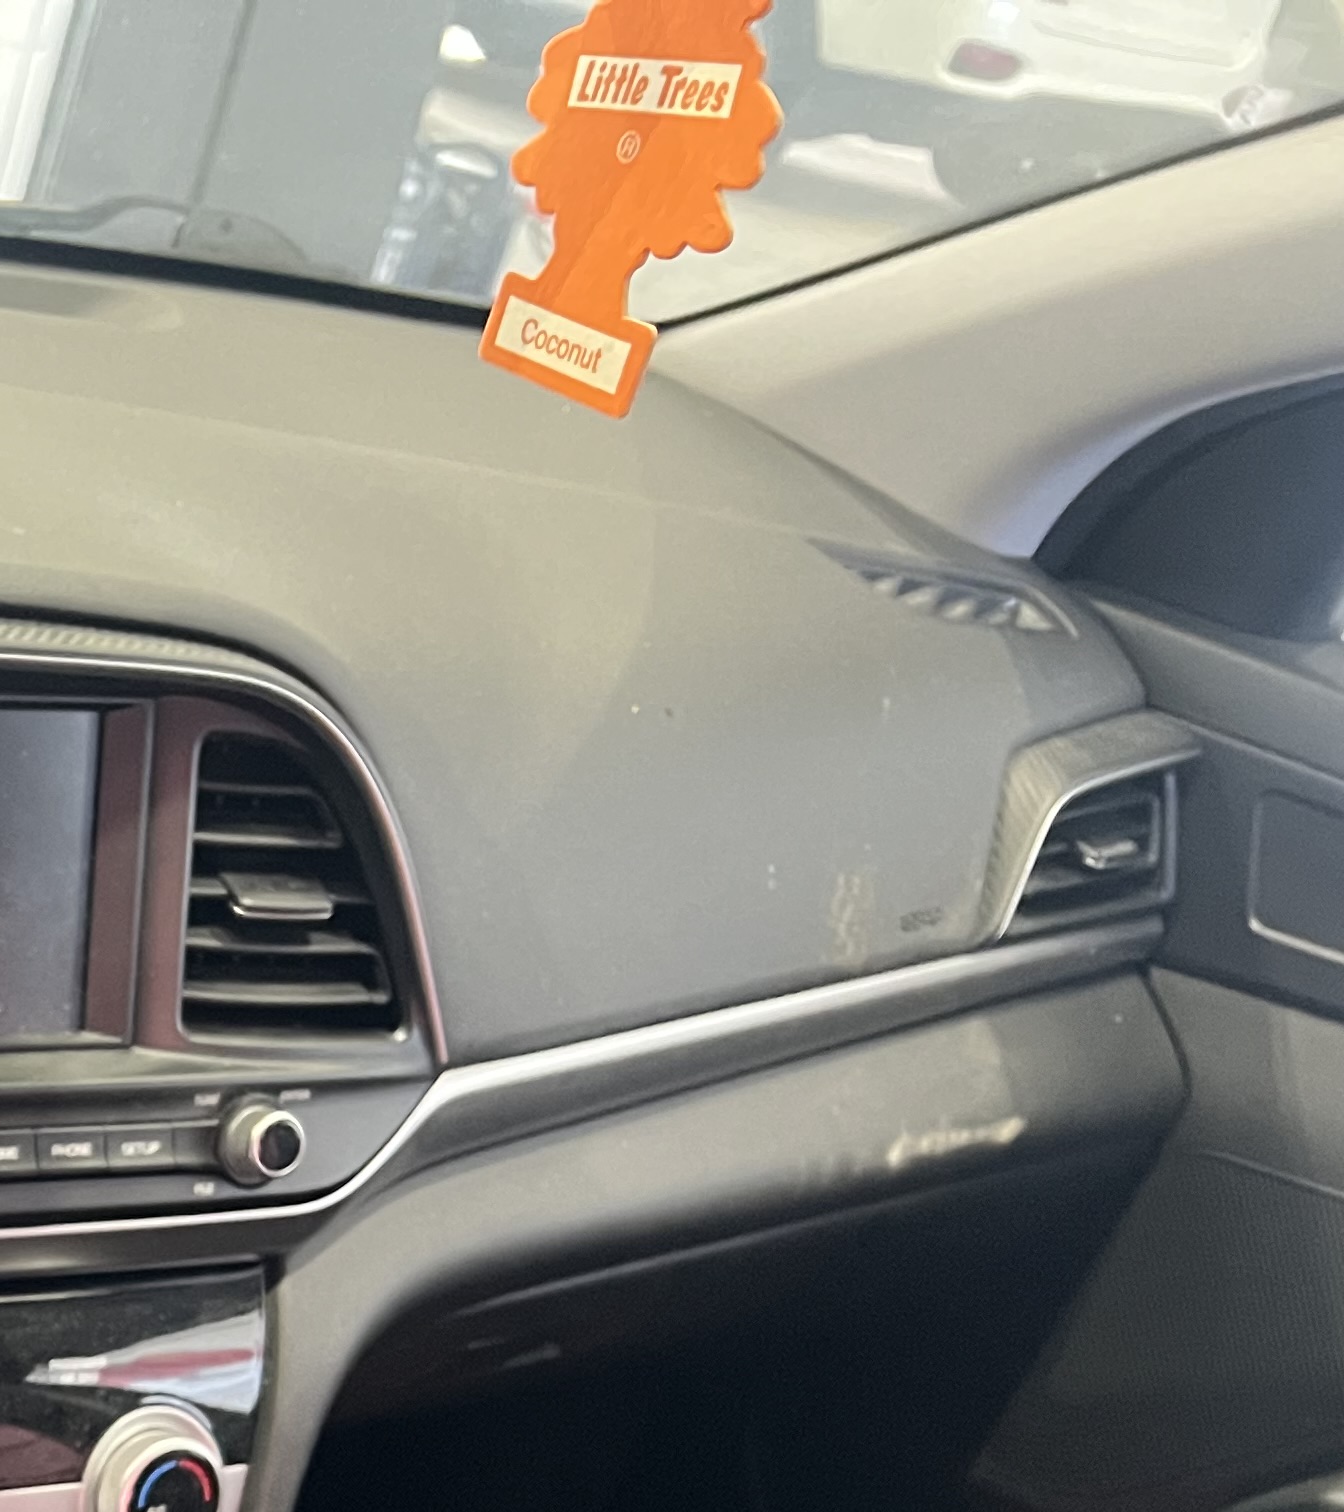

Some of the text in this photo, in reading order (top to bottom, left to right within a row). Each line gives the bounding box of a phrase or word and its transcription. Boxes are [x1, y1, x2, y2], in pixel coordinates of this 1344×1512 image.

[576, 59, 730, 113] Little Trees
[520, 317, 603, 375] Coconut
